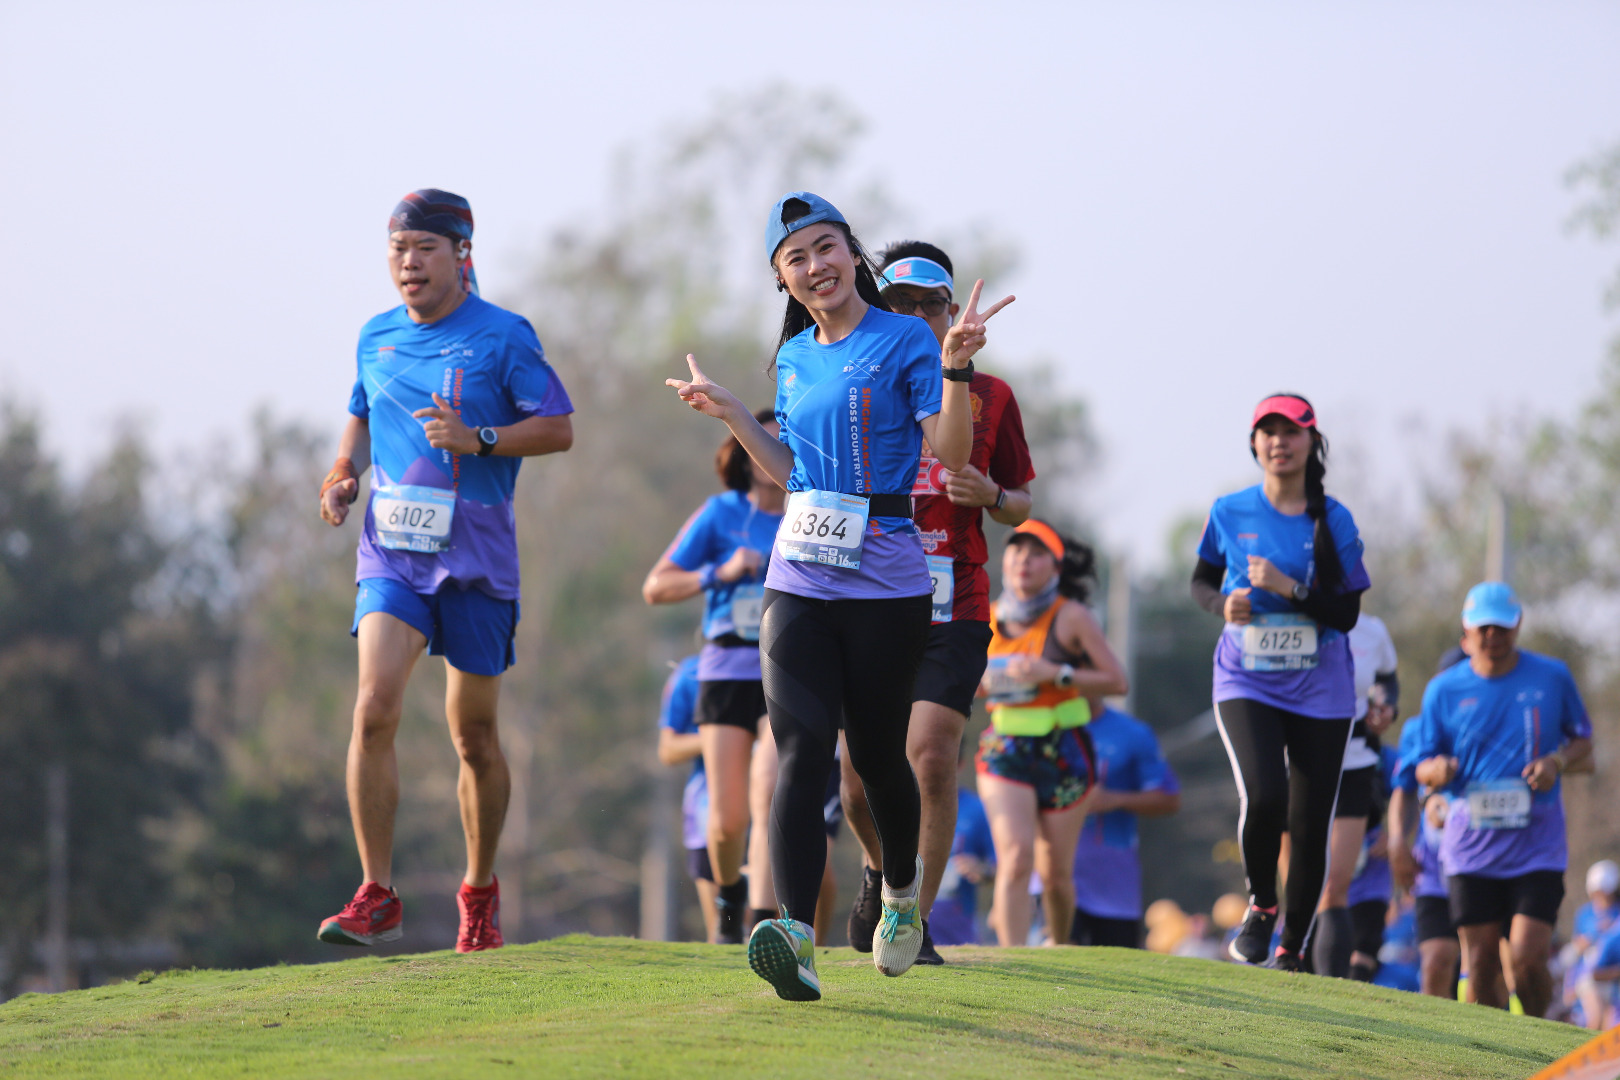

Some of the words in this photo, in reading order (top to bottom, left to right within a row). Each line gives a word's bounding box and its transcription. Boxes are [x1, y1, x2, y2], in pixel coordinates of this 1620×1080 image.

[442, 367, 452, 398] CROSS
[842, 365, 855, 373] SP
[453, 368, 464, 407] SINGHA
[849, 387, 858, 422] CROSS
[861, 387, 871, 434] SINGHA
[851, 425, 861, 477] COUNTRY
[862, 437, 870, 468] PARK
[855, 479, 864, 494] RU
[864, 471, 872, 492] CHI
[389, 505, 436, 529] 6102
[791, 512, 847, 541] 6364
[1259, 630, 1303, 650] 6125
